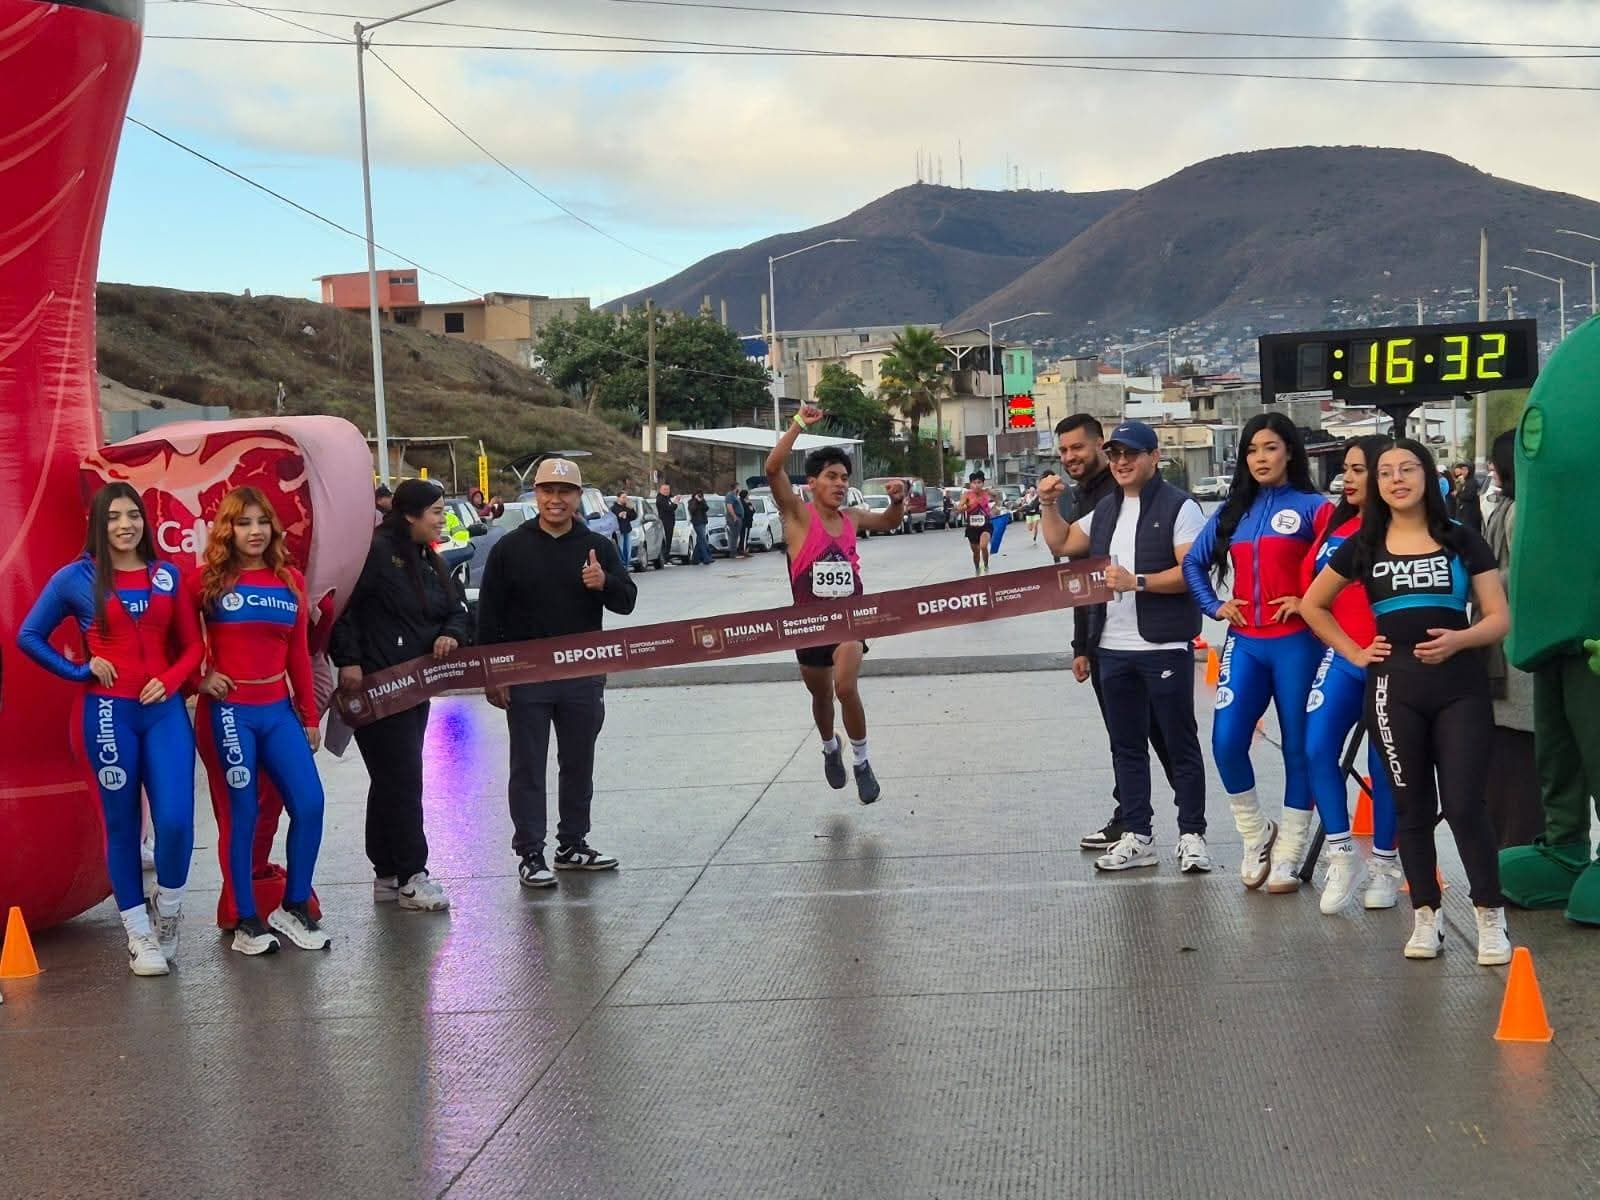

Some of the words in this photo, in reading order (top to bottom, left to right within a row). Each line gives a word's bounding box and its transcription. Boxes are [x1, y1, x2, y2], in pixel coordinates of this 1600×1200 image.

[816, 571, 851, 585] 3952
[1392, 570, 1450, 590] ADE
[853, 606, 878, 617] IMDET
[917, 592, 988, 615] DEPORTE
[783, 615, 829, 627] Secretaría
[831, 612, 843, 621] de
[723, 622, 774, 638] TIJUANA
[784, 625, 825, 636] Bienestar
[490, 655, 515, 664] IMDET
[553, 644, 623, 664] DEPORTE
[1217, 635, 1236, 686] Calimax
[423, 661, 467, 676] Secretaría
[426, 670, 464, 684] Bienestar
[368, 675, 416, 699] TIJUANA
[96, 698, 119, 764] Calimax
[221, 707, 244, 765] Calimax
[1375, 674, 1407, 787] POWERADE
